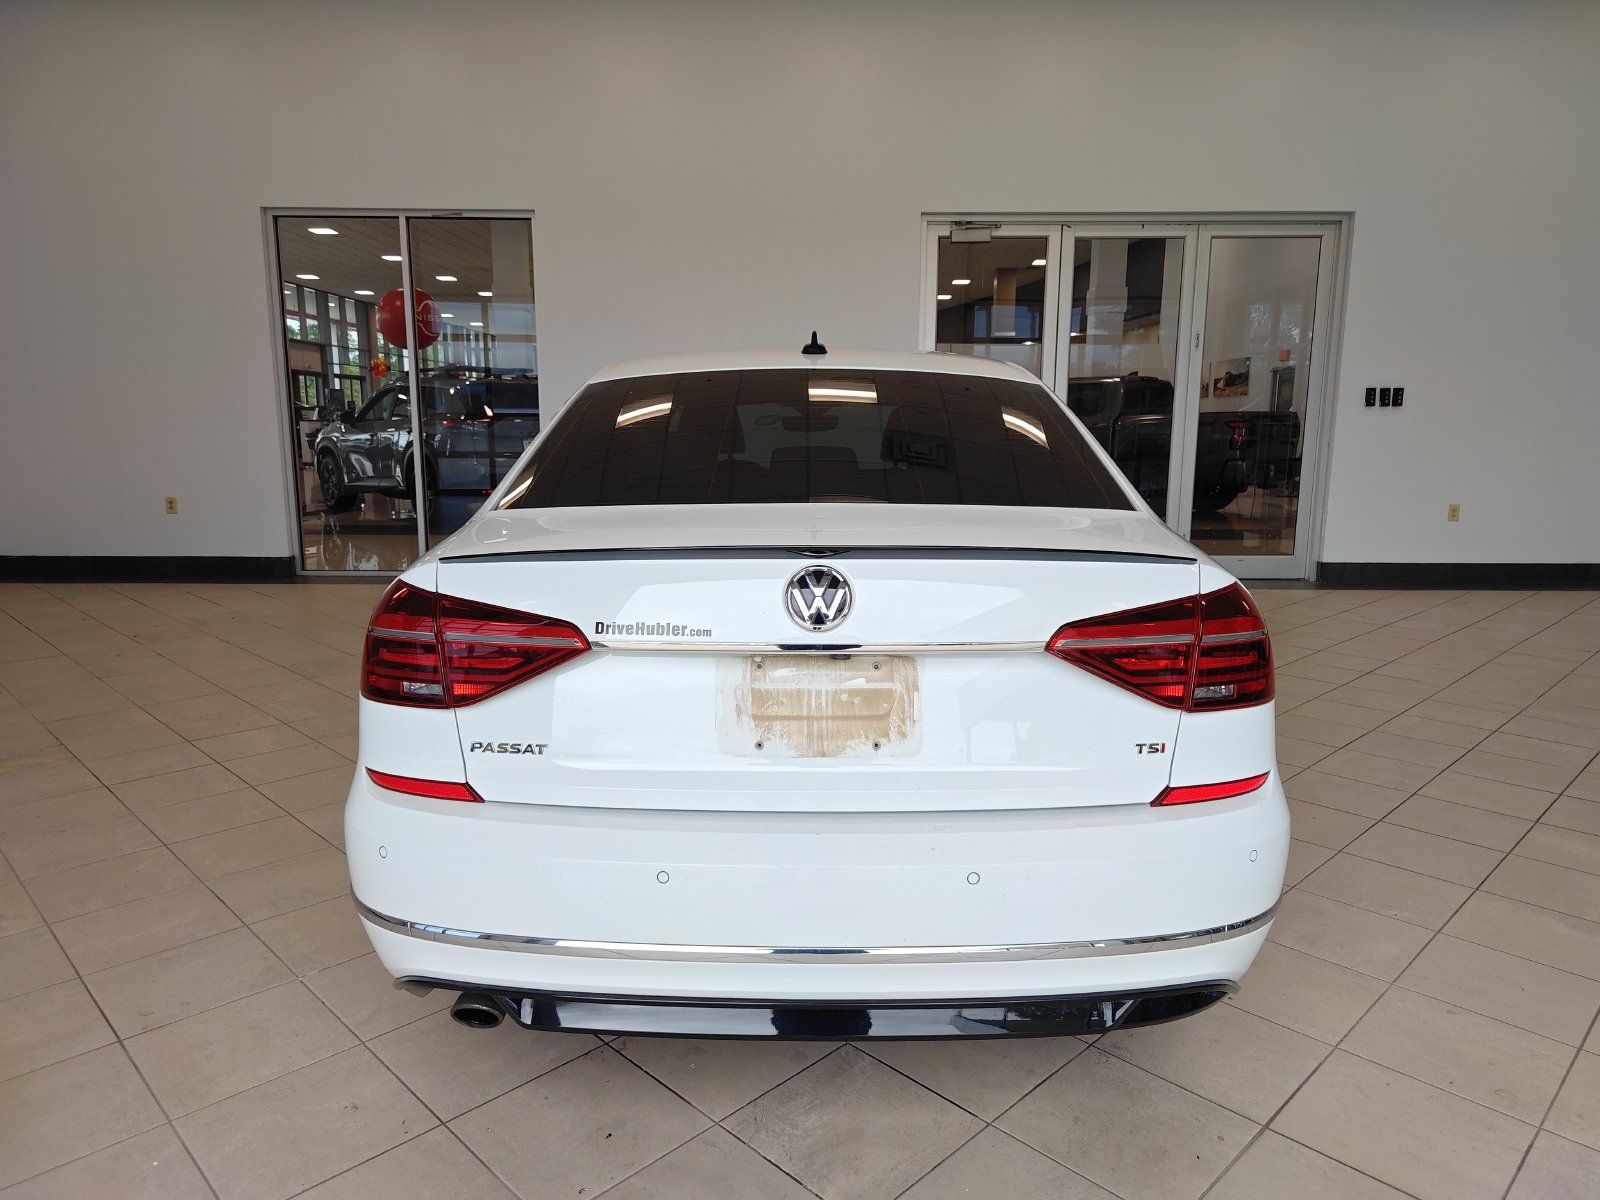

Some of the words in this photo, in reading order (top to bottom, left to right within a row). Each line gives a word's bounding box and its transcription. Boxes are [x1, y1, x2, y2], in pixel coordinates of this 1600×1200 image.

[595, 621, 712, 638] DriveHubler.com
[470, 742, 548, 755] PASSAT
[1135, 743, 1166, 754] TSI
